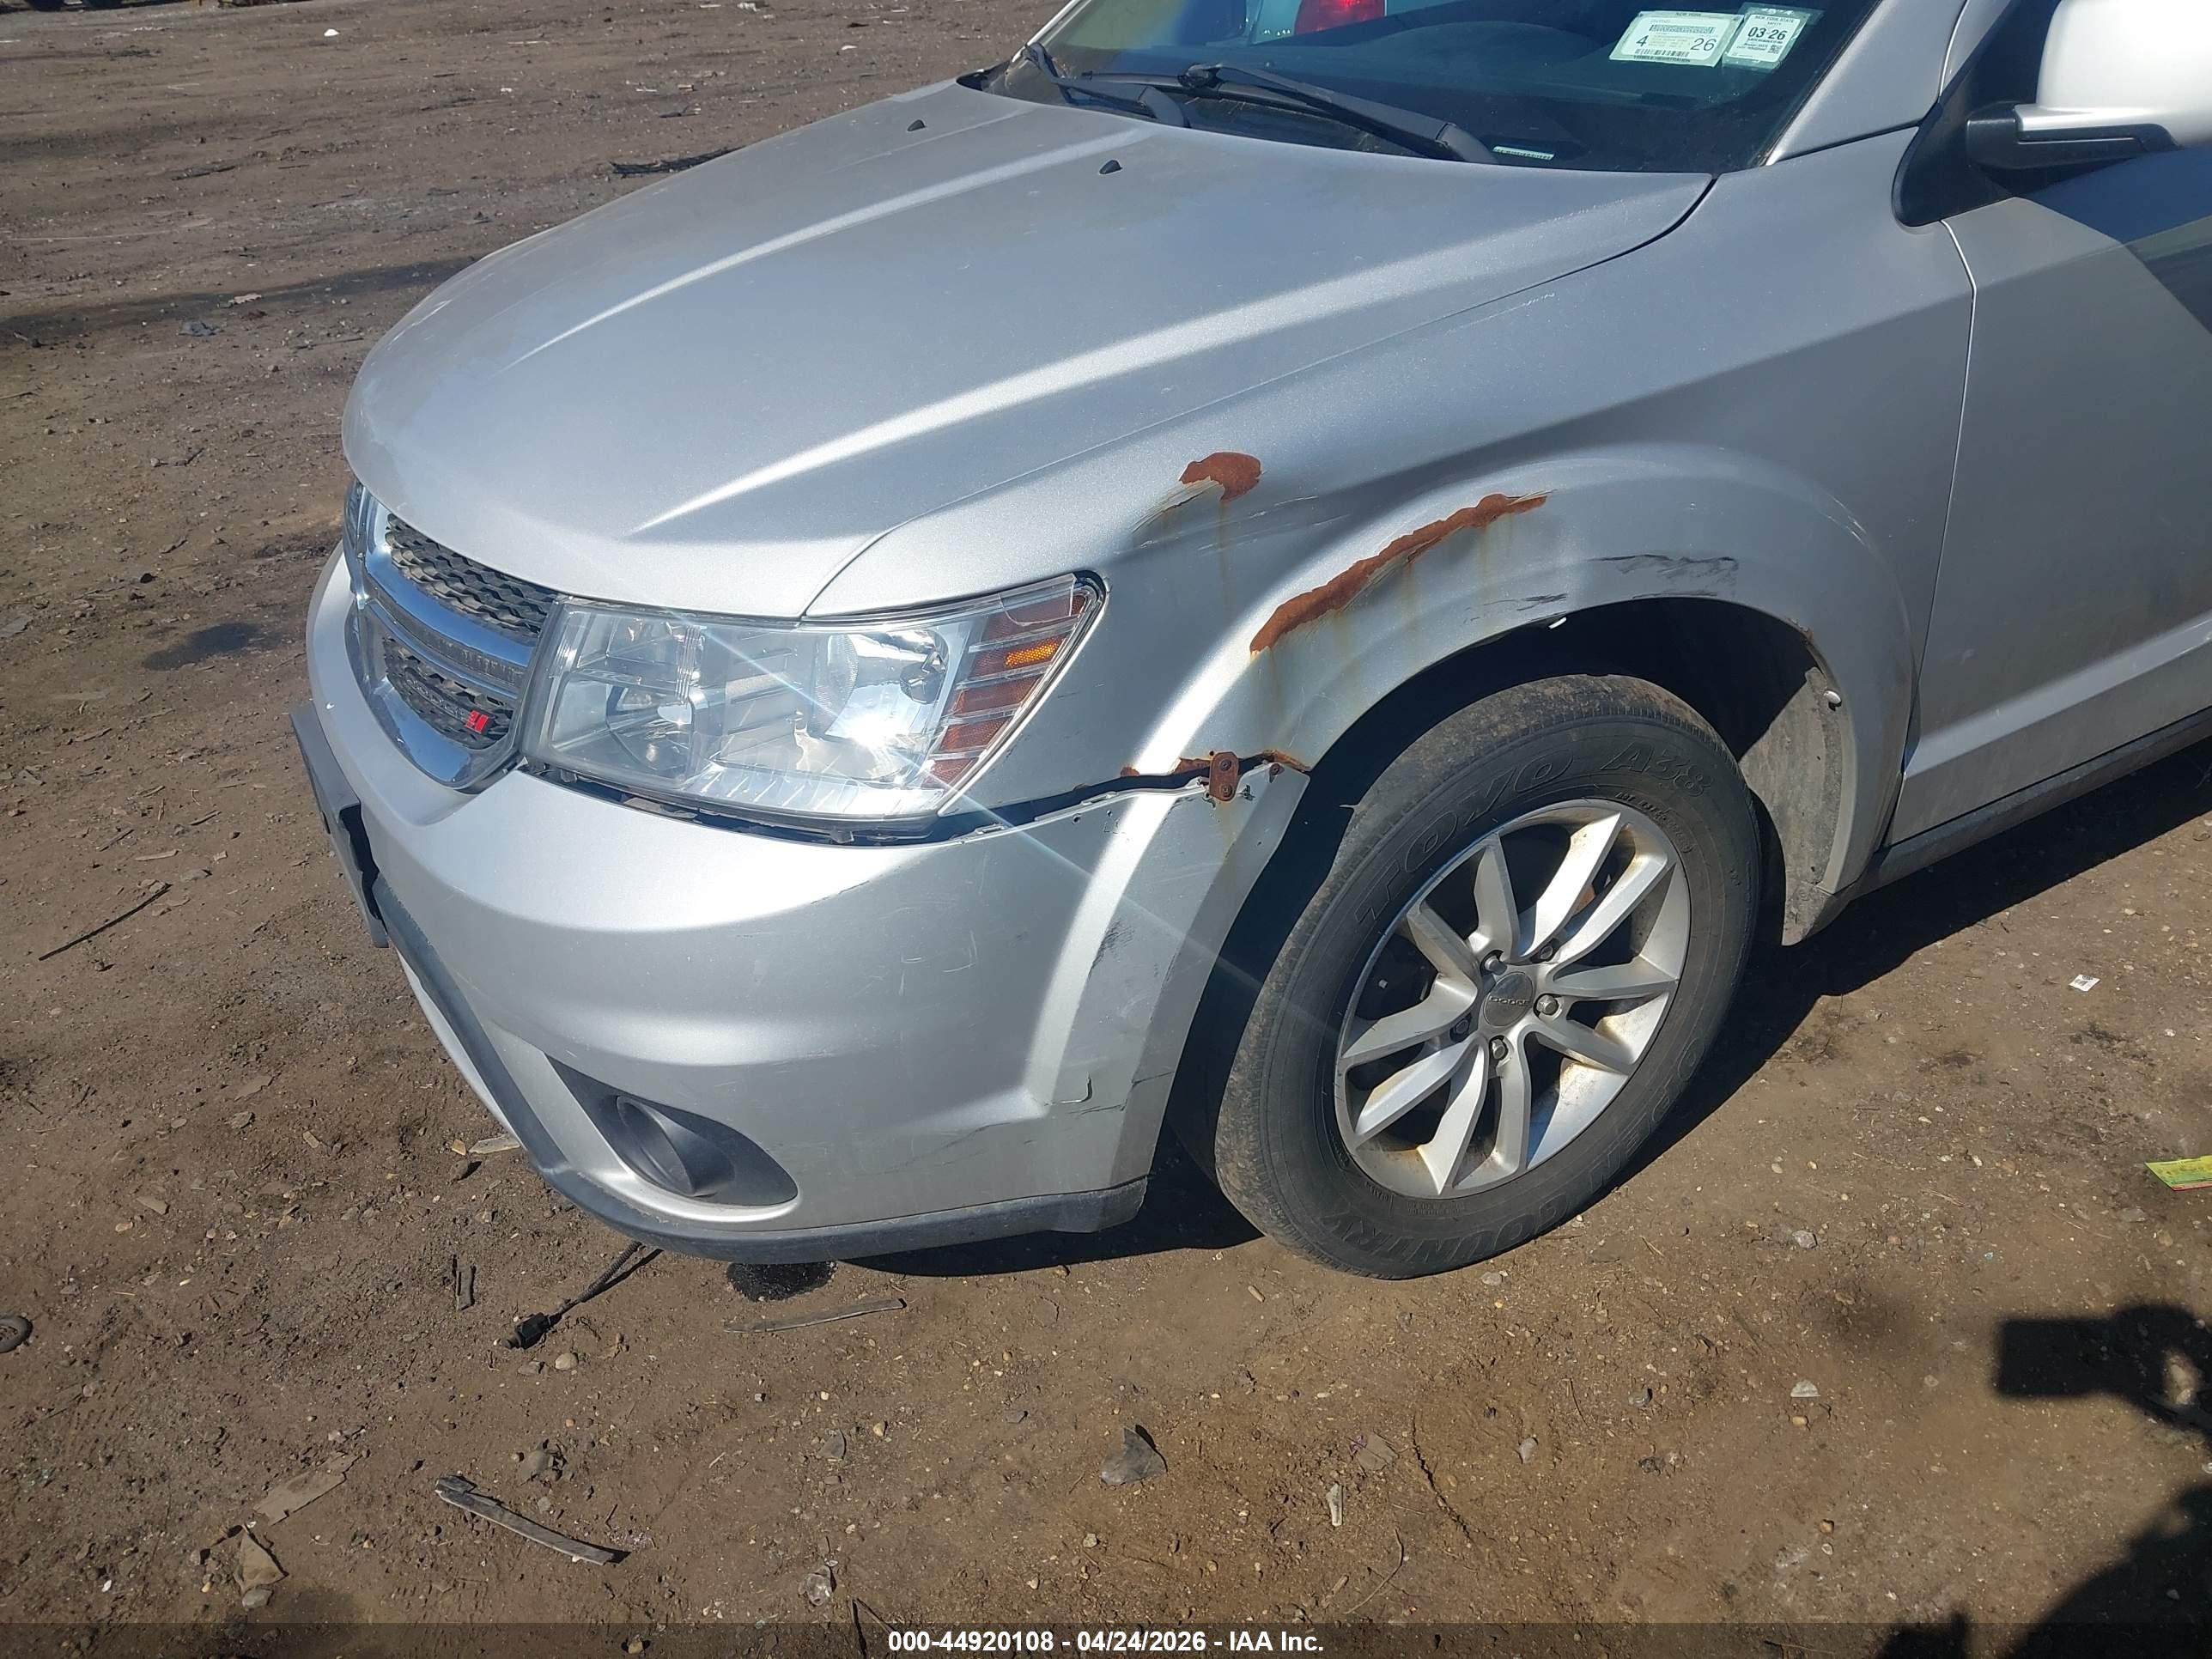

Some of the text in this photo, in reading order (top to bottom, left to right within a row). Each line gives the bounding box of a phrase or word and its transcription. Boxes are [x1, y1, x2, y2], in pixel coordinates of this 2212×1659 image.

[1747, 27, 1787, 40] 03 26
[1636, 34, 1649, 47] 4
[1690, 37, 1717, 52] 26
[1354, 748, 1574, 923] TOYO
